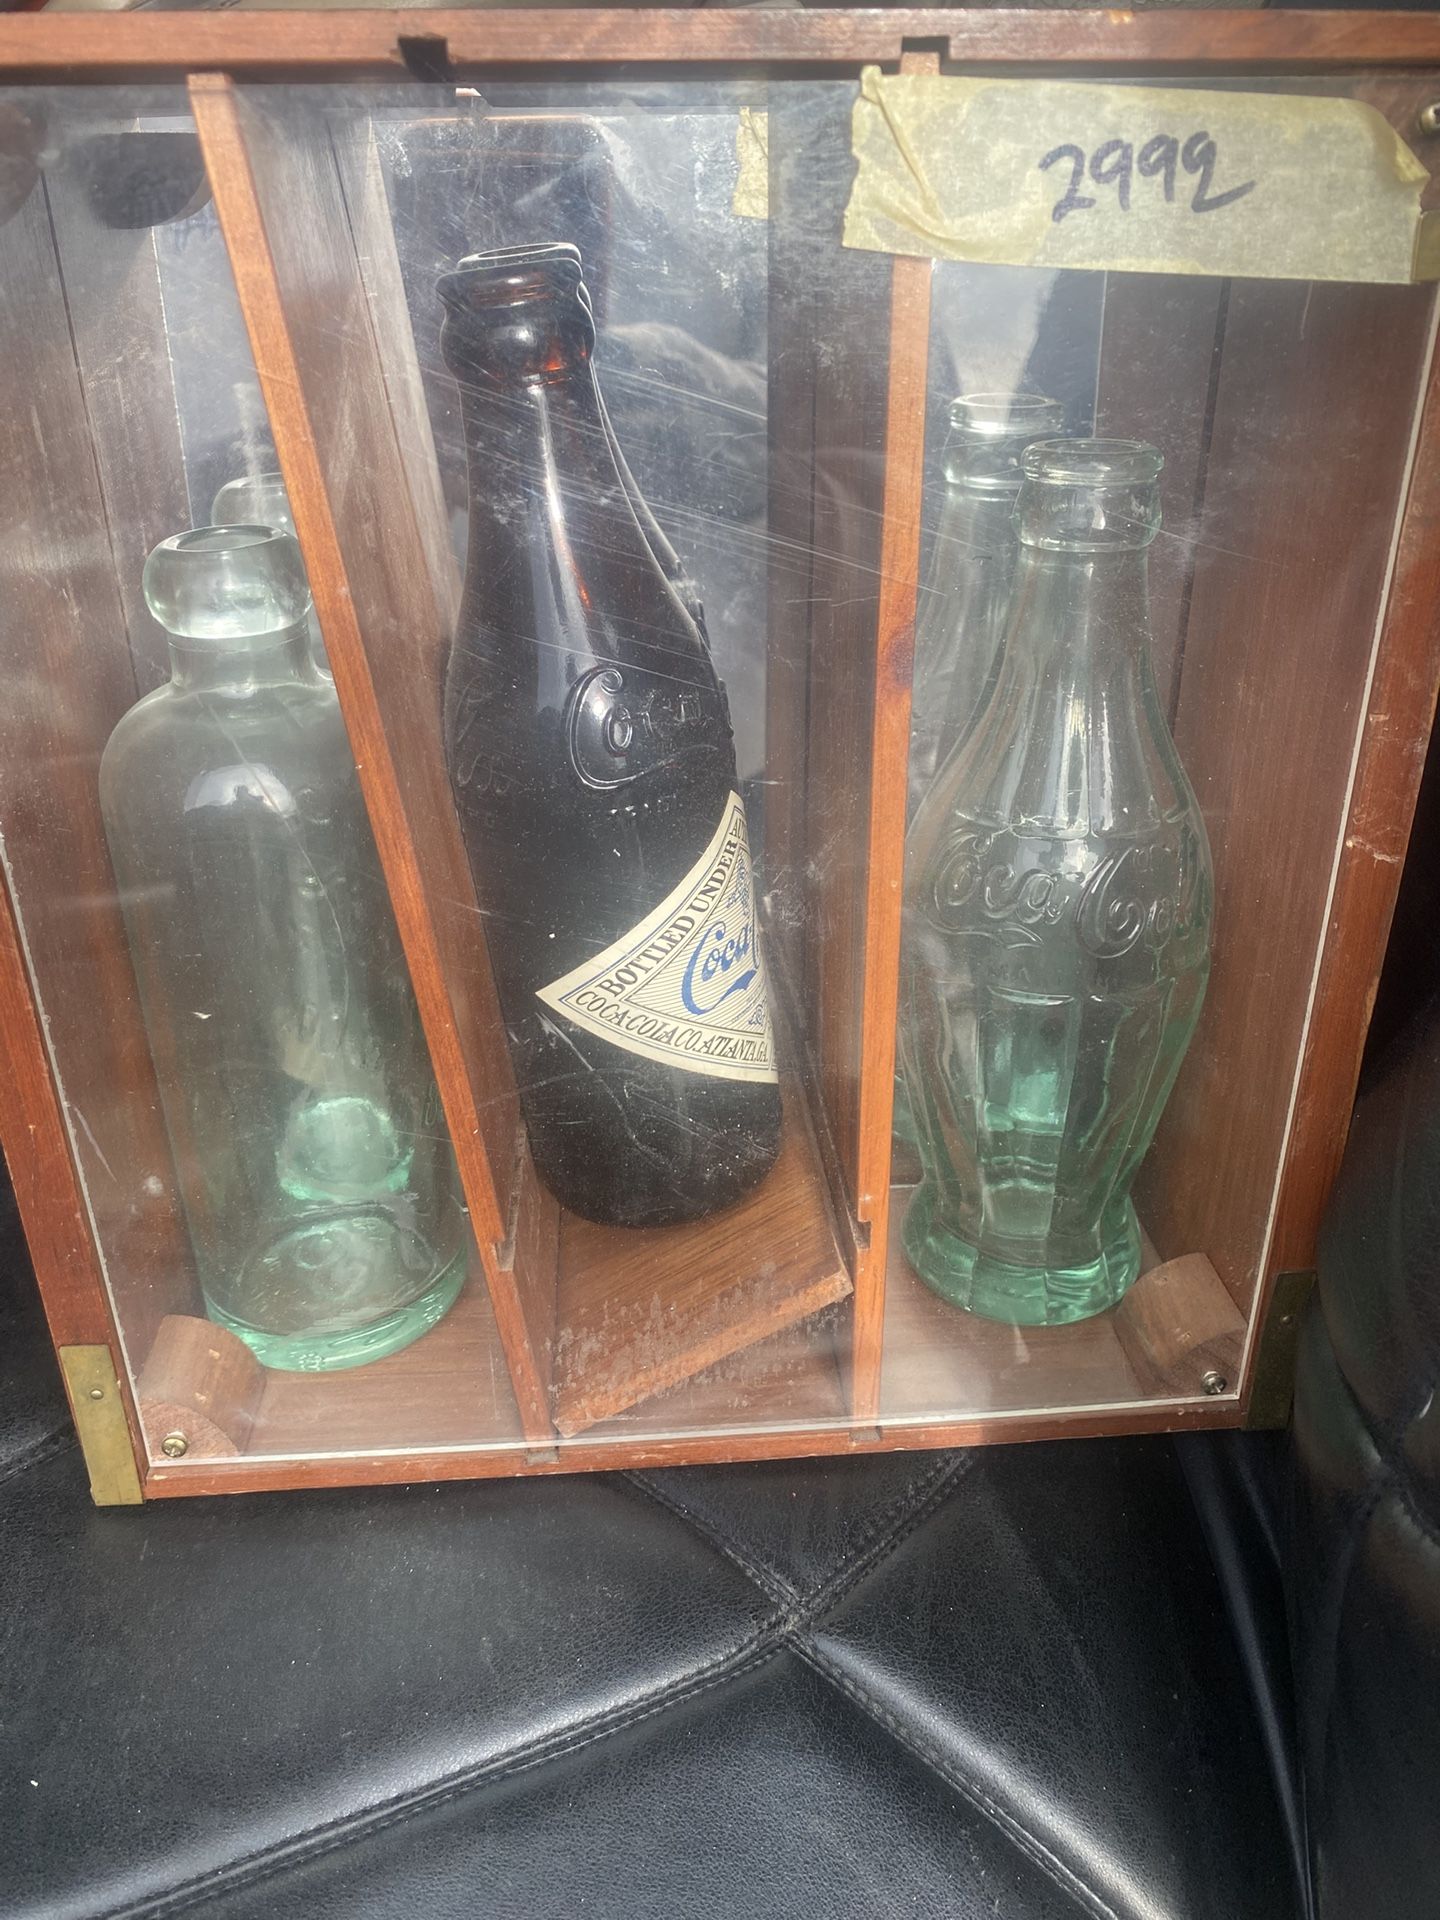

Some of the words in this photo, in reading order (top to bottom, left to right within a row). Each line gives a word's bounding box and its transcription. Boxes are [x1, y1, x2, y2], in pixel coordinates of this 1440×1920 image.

[595, 915, 696, 997] BOTTLED
[686, 839, 738, 913] UNDER
[575, 990, 673, 1046] COCA-COLA
